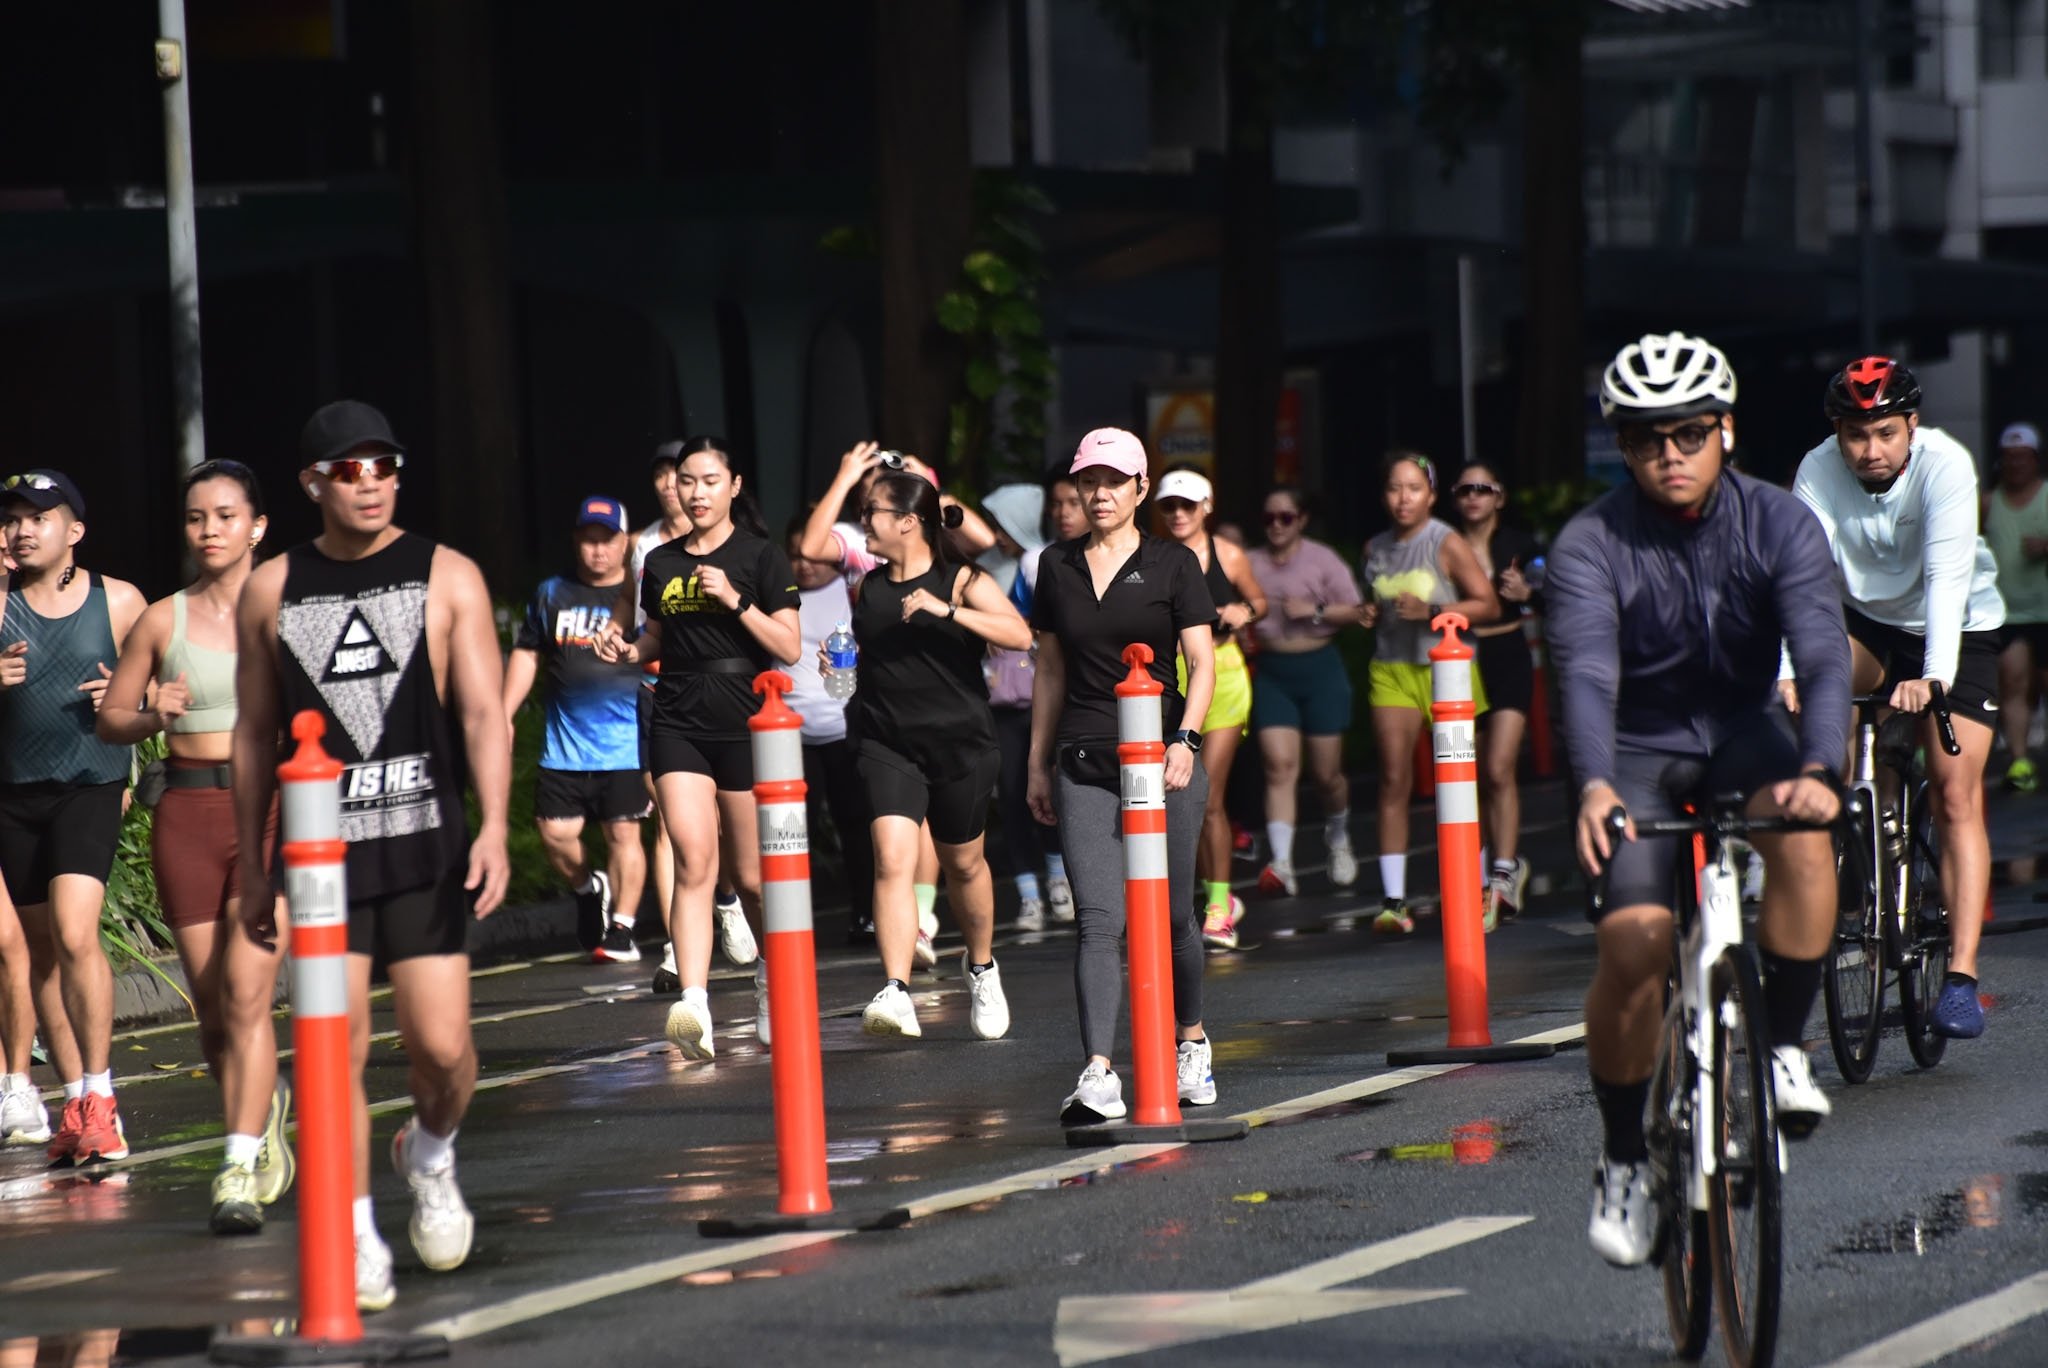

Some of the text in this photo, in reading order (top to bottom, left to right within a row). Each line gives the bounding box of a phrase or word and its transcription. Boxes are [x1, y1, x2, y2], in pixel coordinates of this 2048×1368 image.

[301, 594, 345, 604] AWESOME
[357, 588, 384, 600] CUTE
[347, 766, 383, 798] IS
